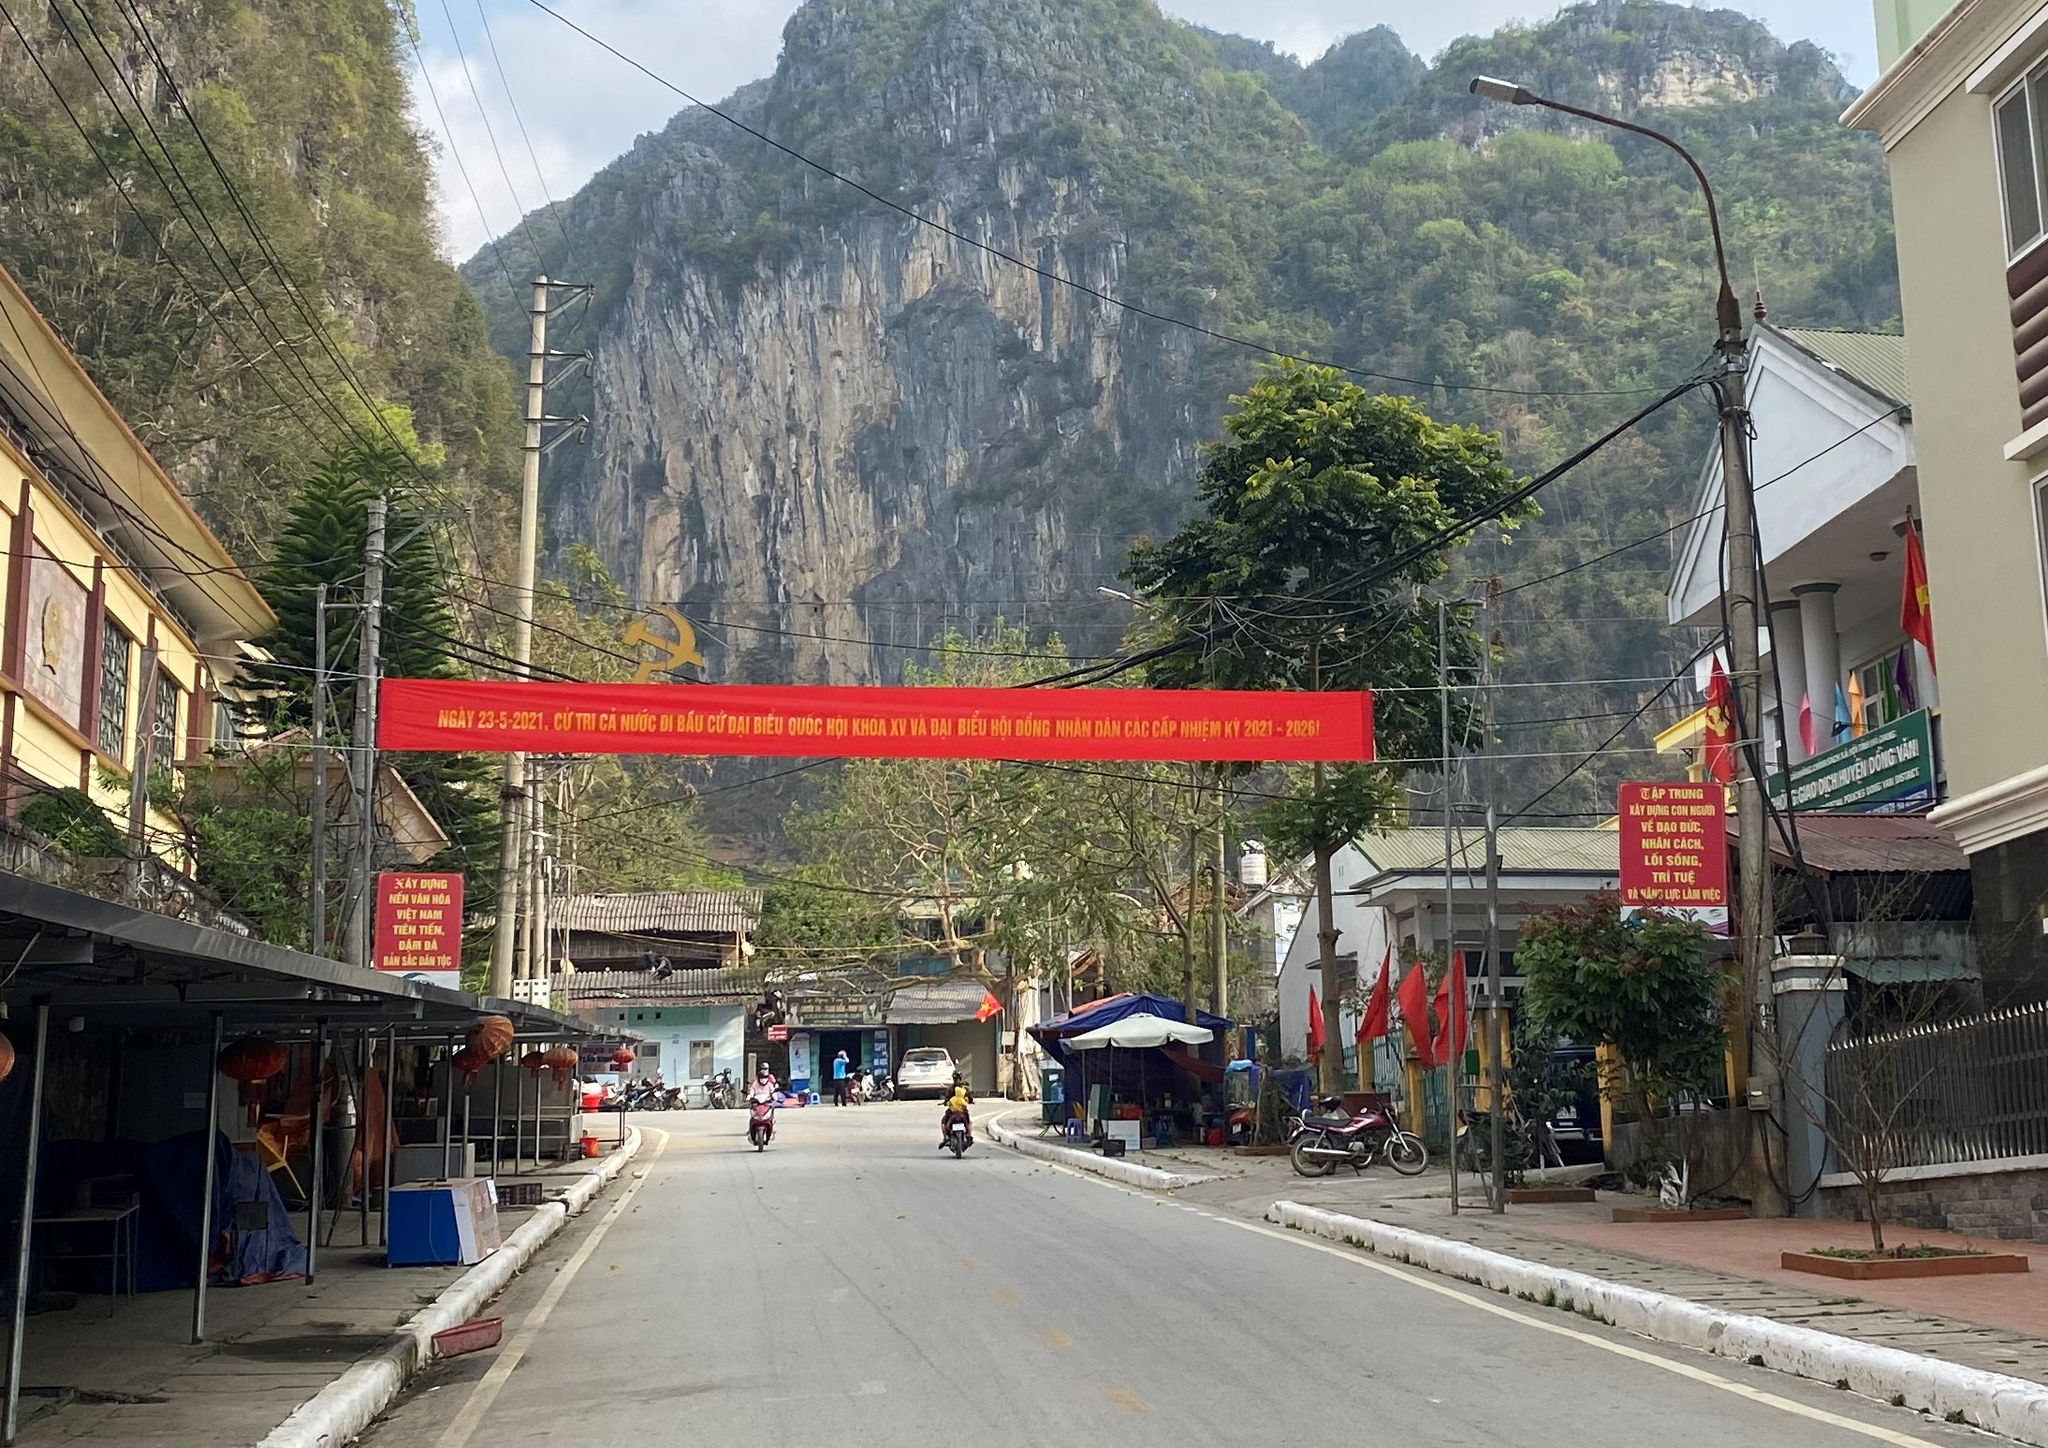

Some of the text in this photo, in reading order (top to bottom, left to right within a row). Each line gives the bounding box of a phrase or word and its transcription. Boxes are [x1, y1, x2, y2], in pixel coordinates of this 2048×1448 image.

[438, 707, 474, 729] NGÀY
[576, 713, 596, 731] TRI
[599, 707, 616, 732] CẢ
[620, 709, 657, 733] NƯỚC
[660, 714, 674, 733] ĐI
[677, 709, 703, 733] BẦU
[728, 715, 750, 738] ĐẠI
[754, 707, 784, 735] BIỂU
[788, 712, 823, 736] QUỐC
[826, 714, 848, 739] HỘI
[890, 718, 906, 737] XV
[910, 714, 927, 736] VÀ
[930, 717, 952, 740] ĐẠI
[958, 710, 987, 737] BIỂU
[990, 715, 1012, 741] HỘI
[1015, 712, 1050, 738] ĐỒNG
[1056, 716, 1091, 738] NHÂN
[1095, 716, 1121, 738] DÂN
[1124, 716, 1149, 738] CÁC
[1152, 715, 1177, 738] CẤP
[1180, 717, 1221, 742] NHIỆM
[1244, 719, 1273, 738] 2021
[1285, 719, 1321, 738] 2026!
[1770, 789, 1800, 811] PHÒG
[1799, 781, 1818, 804] GIAO
[1818, 773, 1839, 798] DỊCH
[1839, 757, 1868, 786] HUYỆN
[1896, 737, 1920, 763] VĂN
[1640, 786, 1704, 801] TẬP TRUNG
[1629, 802, 1716, 818] XÂY DỰNG CON NGƯỜI
[1656, 821, 1677, 835] ĐẠO
[1680, 818, 1704, 834] ĐỨC,
[1642, 836, 1671, 849] NHÂN
[1644, 852, 1663, 867] LỐI
[394, 877, 448, 891] XÂY DỰNG
[1652, 870, 1696, 886] TRÍ TUỆ
[389, 891, 451, 905] NỀN VĂN HÓA
[1628, 887, 1639, 900] VÀ
[1665, 888, 1681, 902] LỰC
[1682, 887, 1700, 900] LÀM
[1702, 887, 1721, 903] VIỆC
[396, 908, 443, 922] VIỆT NAM
[392, 922, 416, 935] TIÊN
[399, 938, 438, 953] ĐẬM ĐÀ
[383, 950, 452, 968] BẢN SẮC DÂN TỘC
